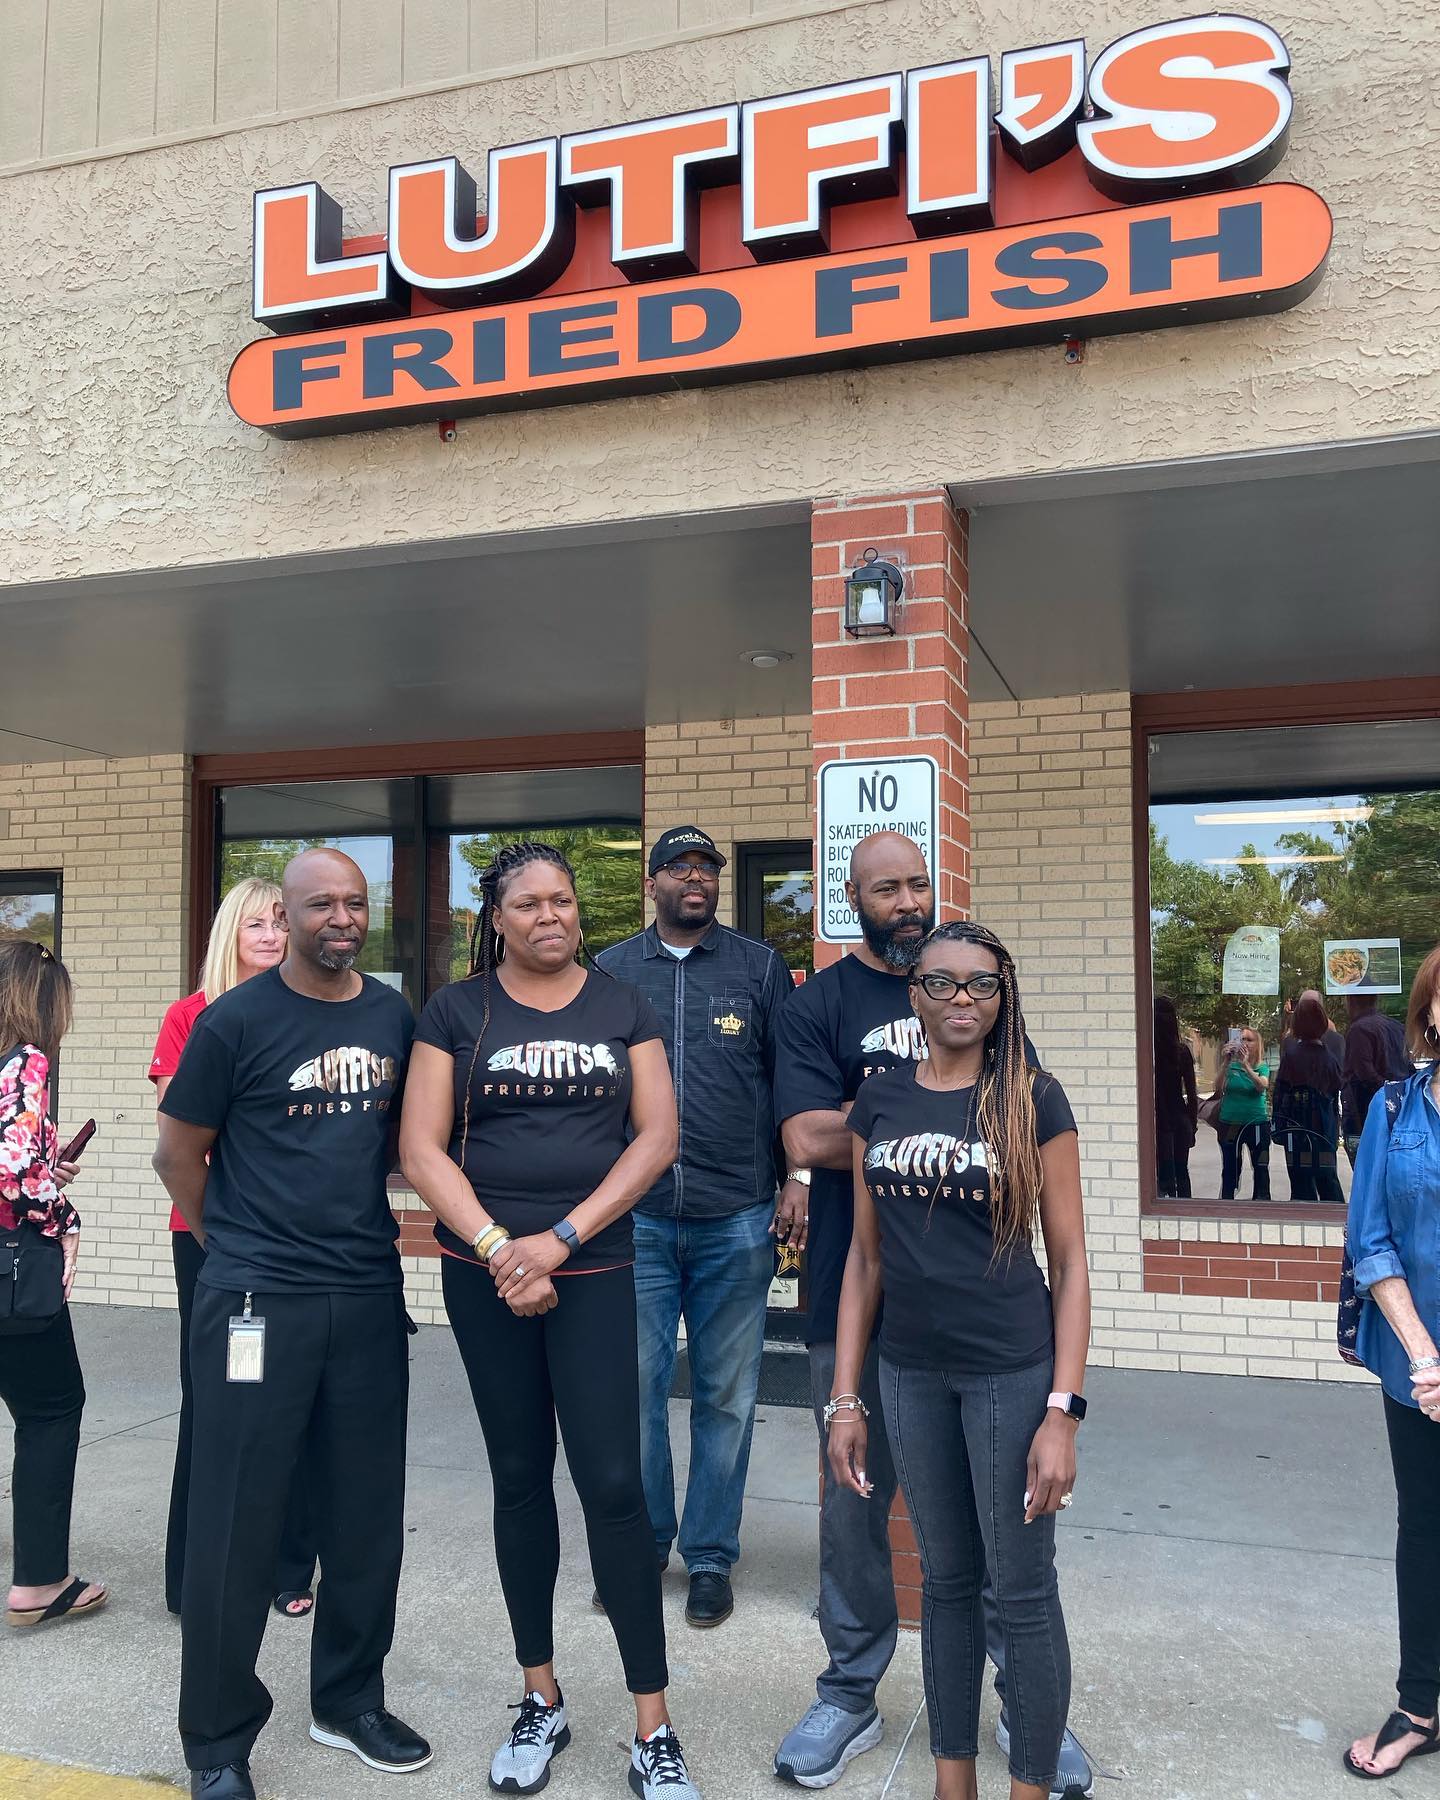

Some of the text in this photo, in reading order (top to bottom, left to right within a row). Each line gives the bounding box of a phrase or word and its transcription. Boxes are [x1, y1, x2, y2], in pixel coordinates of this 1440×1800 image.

[253, 13, 1291, 322] LUTFI'S
[272, 202, 1262, 412] FRIED FISH
[858, 774, 898, 812] NO
[1250, 952, 1270, 961] Hiring
[483, 1084, 554, 1097] FRIED
[287, 1100, 352, 1116] FRIED
